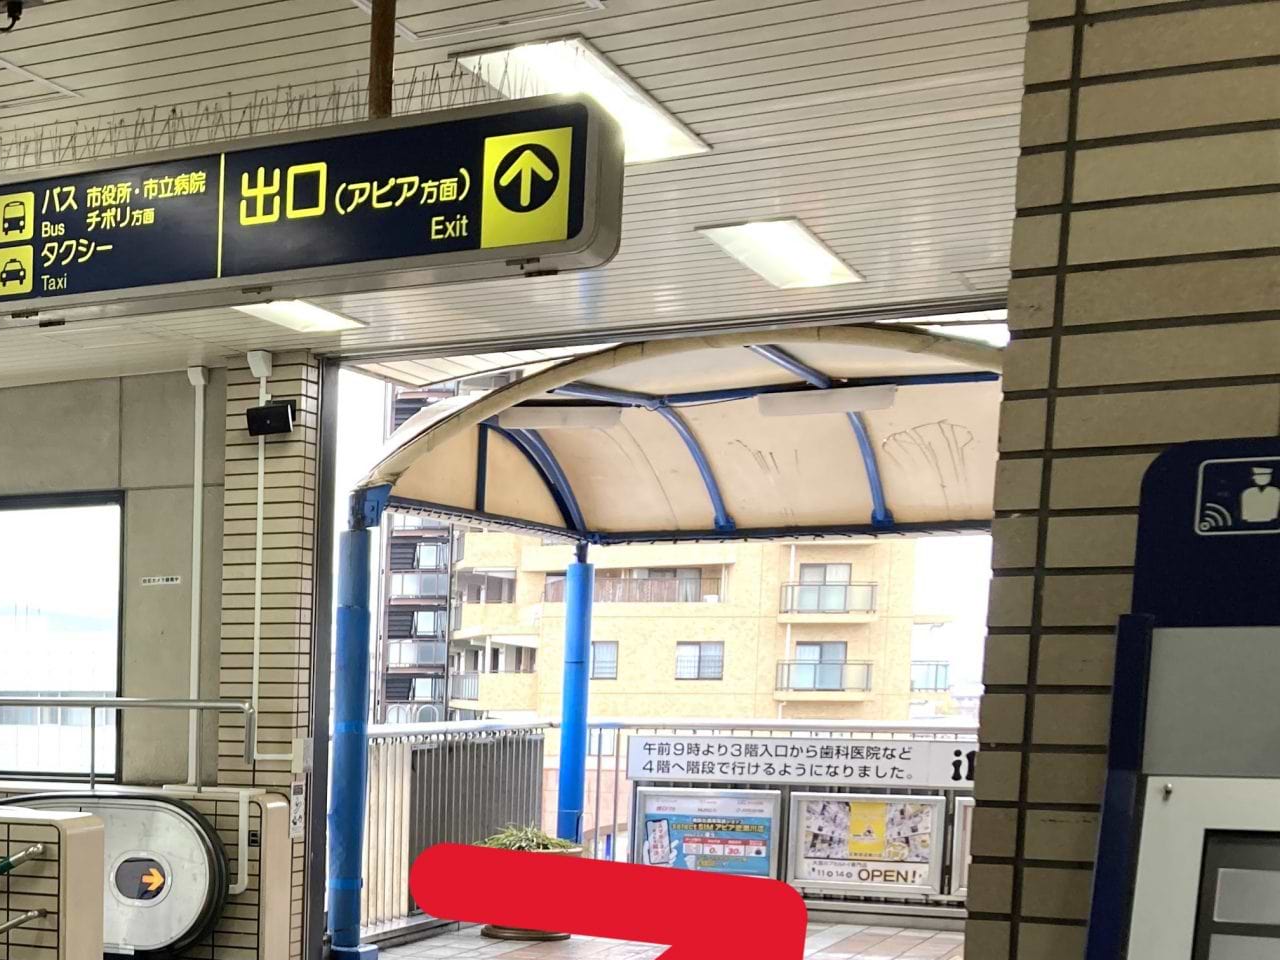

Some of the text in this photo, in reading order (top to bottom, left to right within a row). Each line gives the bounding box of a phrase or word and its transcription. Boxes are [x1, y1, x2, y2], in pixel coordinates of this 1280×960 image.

[42, 186, 78, 214] バス
[86, 170, 206, 208] 市役所・市立病院
[239, 161, 327, 226] 出口
[42, 221, 65, 238] Bus
[430, 214, 469, 240] Exit
[41, 238, 113, 268] タクシー
[41, 273, 67, 291] Taxi
[858, 868, 917, 884] OPEN!
